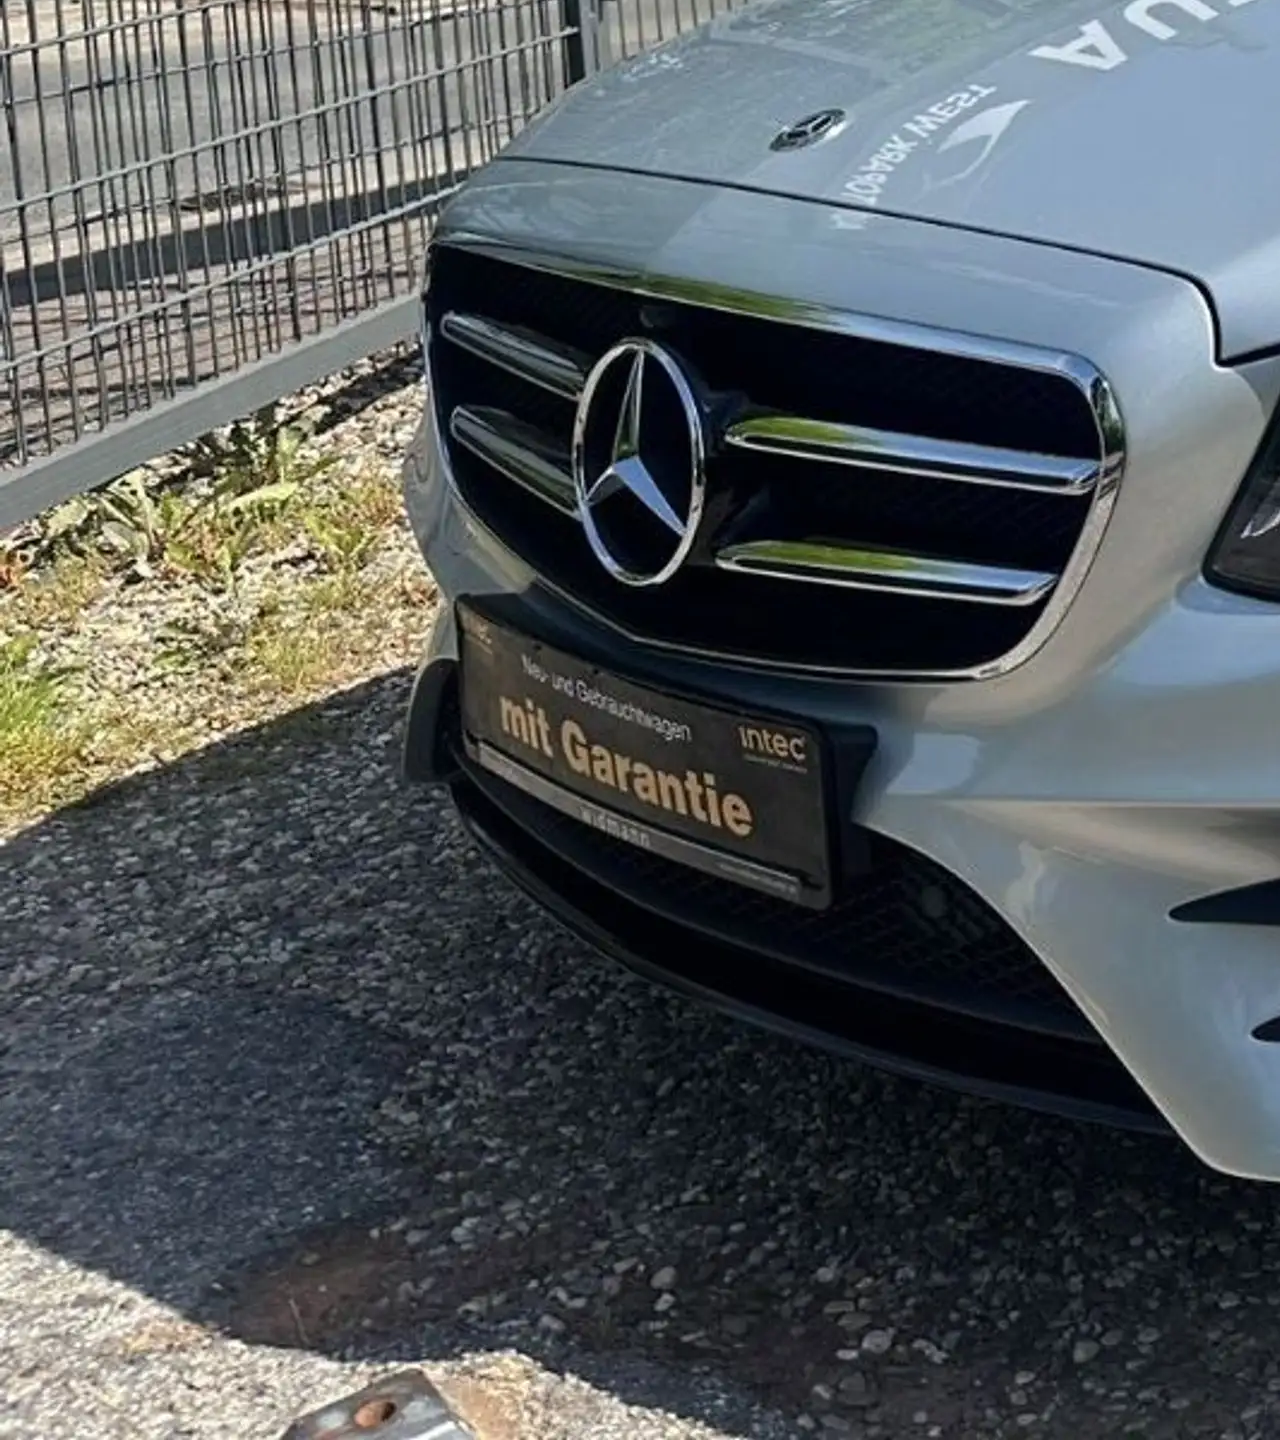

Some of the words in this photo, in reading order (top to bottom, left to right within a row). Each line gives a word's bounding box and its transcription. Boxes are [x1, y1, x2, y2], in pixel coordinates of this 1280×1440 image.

[551, 671, 575, 698] und
[575, 679, 693, 744] Gebrauchtwagen
[738, 723, 806, 762] intec
[499, 693, 554, 760] mit
[561, 718, 754, 839] Garantie
